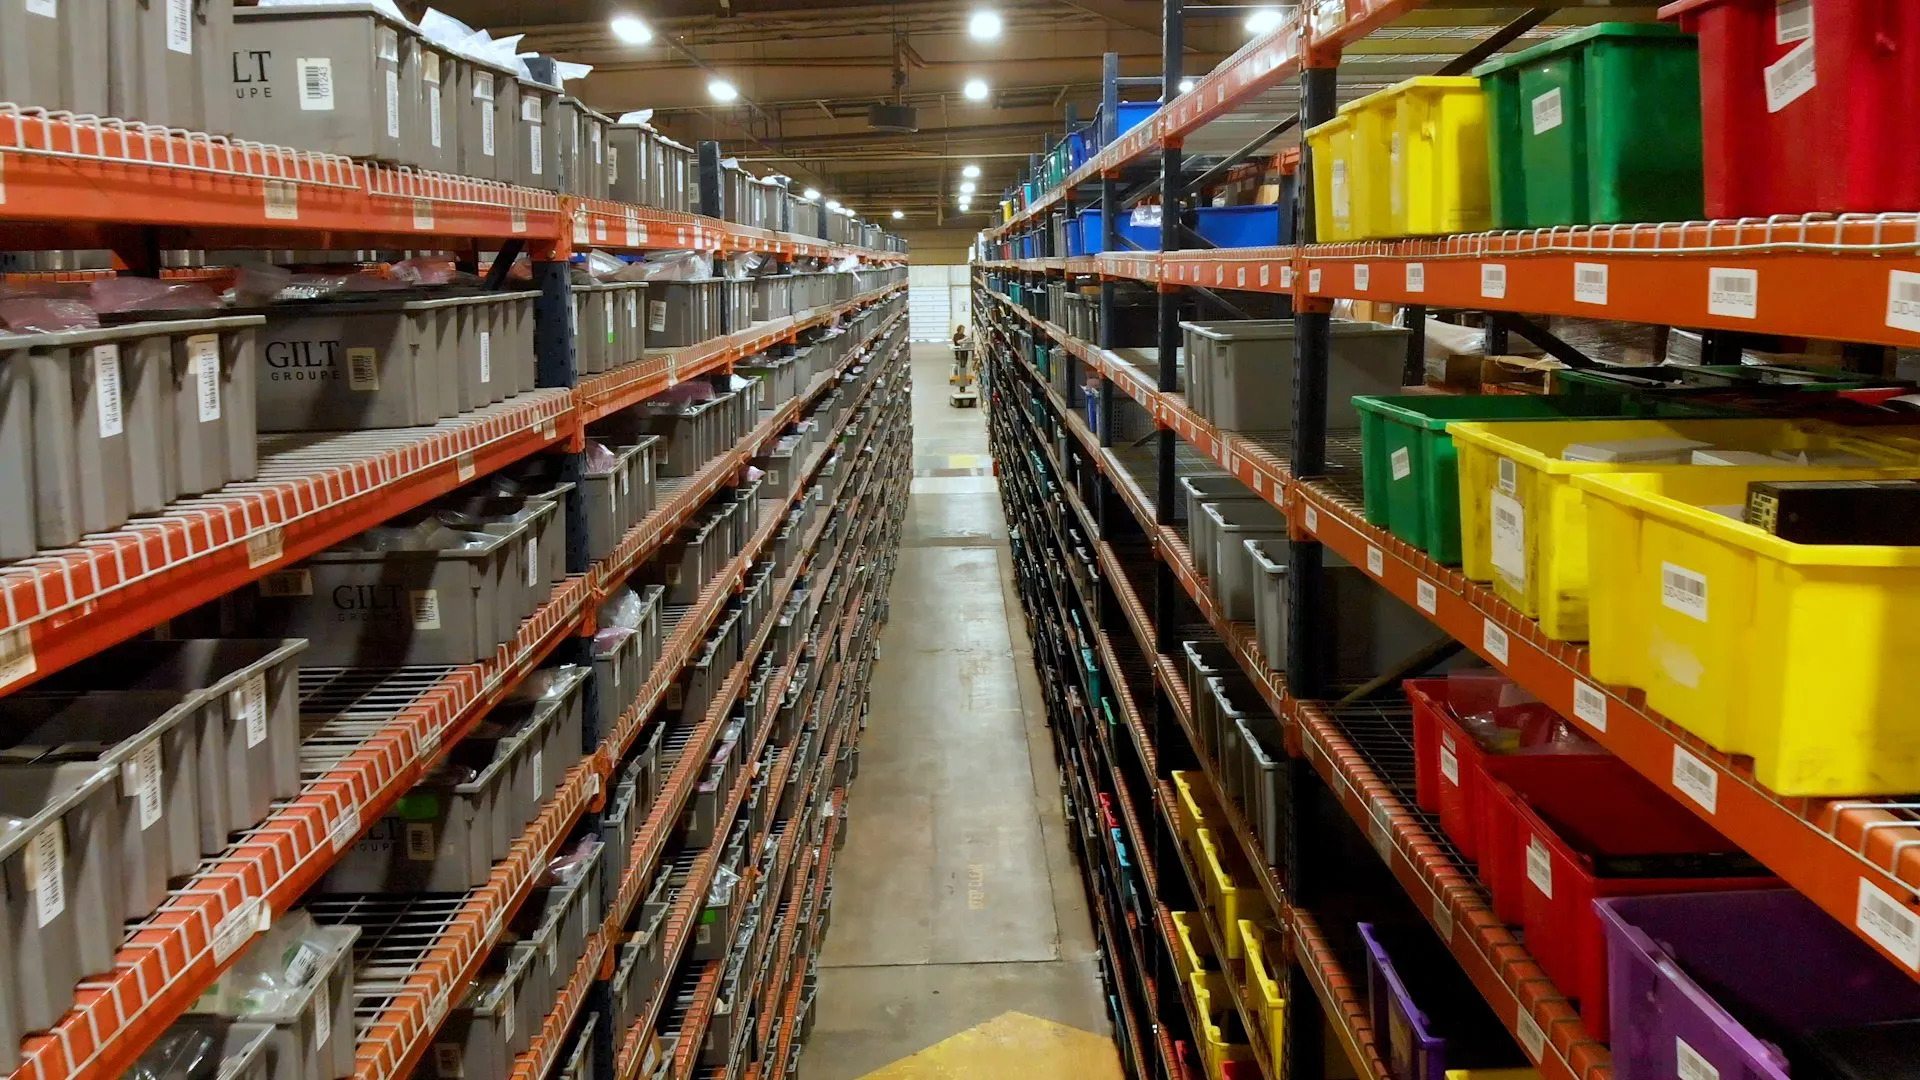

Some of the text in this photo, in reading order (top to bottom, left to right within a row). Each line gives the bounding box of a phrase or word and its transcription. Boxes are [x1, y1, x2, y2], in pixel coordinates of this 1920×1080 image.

[265, 340, 340, 368] GILT
[271, 370, 341, 381] GROUPE
[332, 584, 403, 610] GILT
